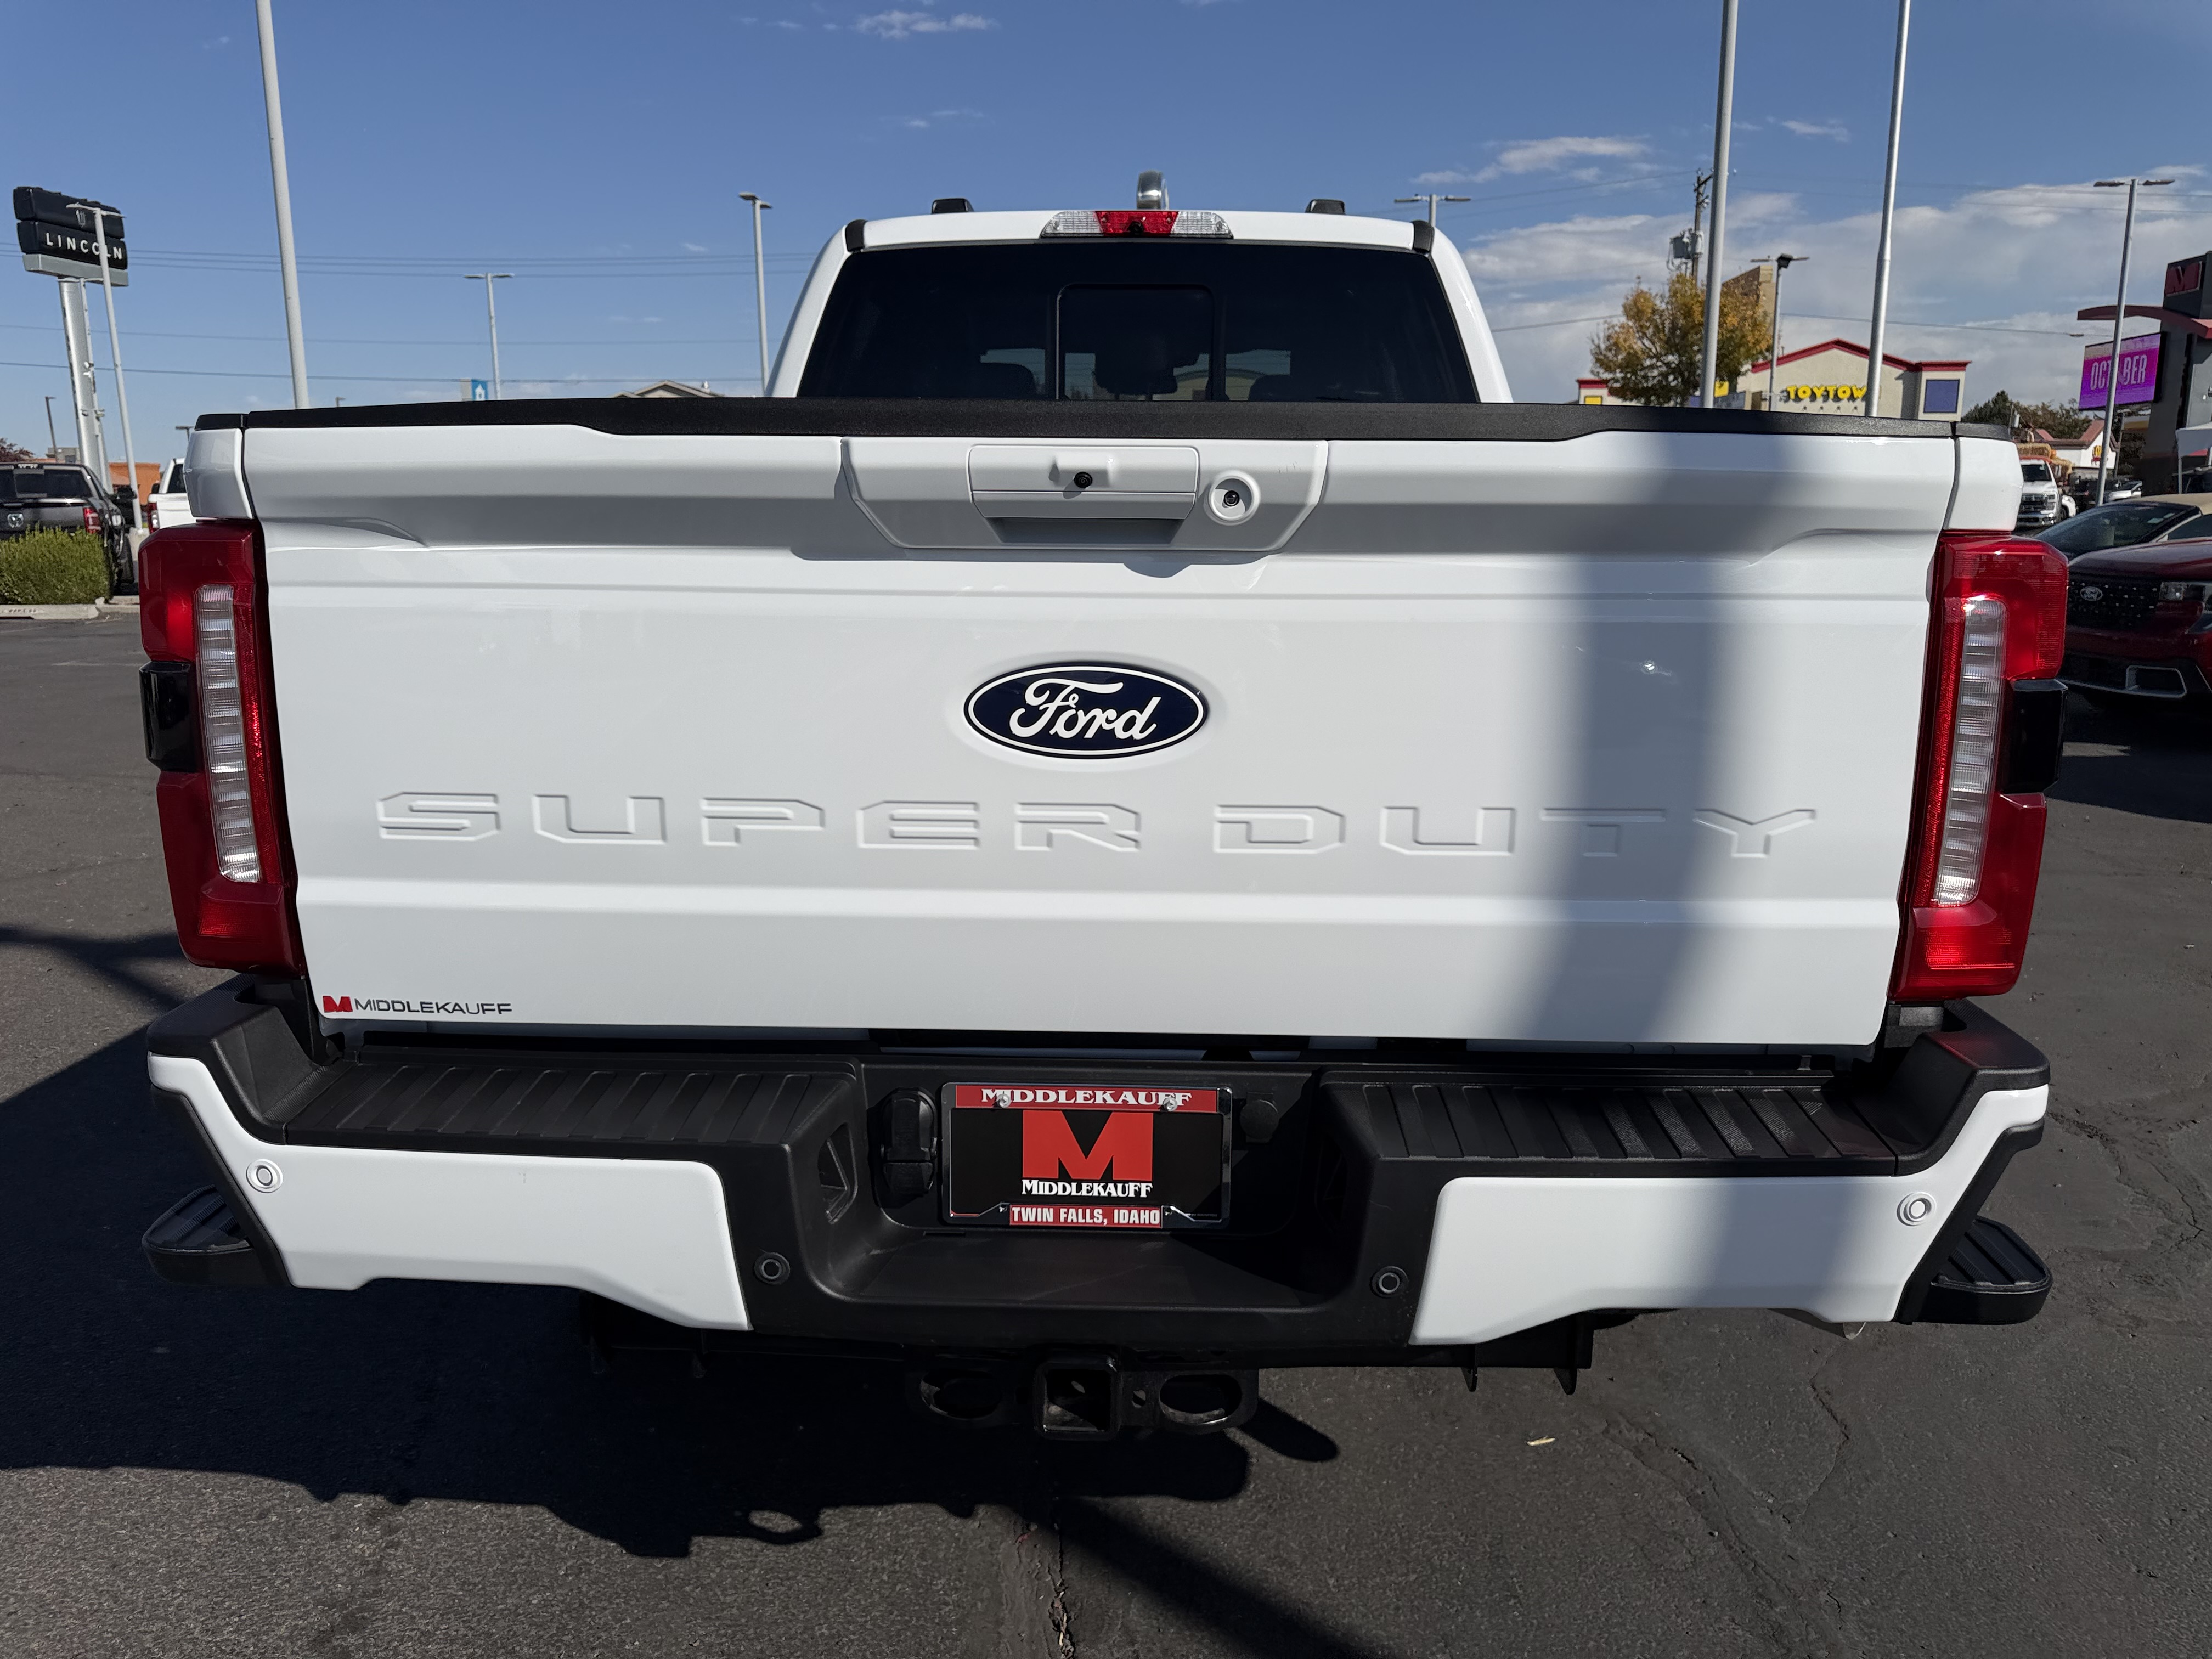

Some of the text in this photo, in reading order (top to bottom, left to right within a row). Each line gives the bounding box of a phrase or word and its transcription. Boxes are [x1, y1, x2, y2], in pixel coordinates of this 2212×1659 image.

[2090, 354, 2147, 390] OCTBER
[1009, 678, 1161, 740] Ford
[375, 792, 1816, 857] SUPER DUTY
[354, 998, 512, 1014] MIDDLEKAUFF
[1022, 1110, 1153, 1181] M
[1022, 1179, 1153, 1198] MIDDLEKAUFF
[1012, 1207, 1160, 1225] TWIN FALLS, IDAHO
